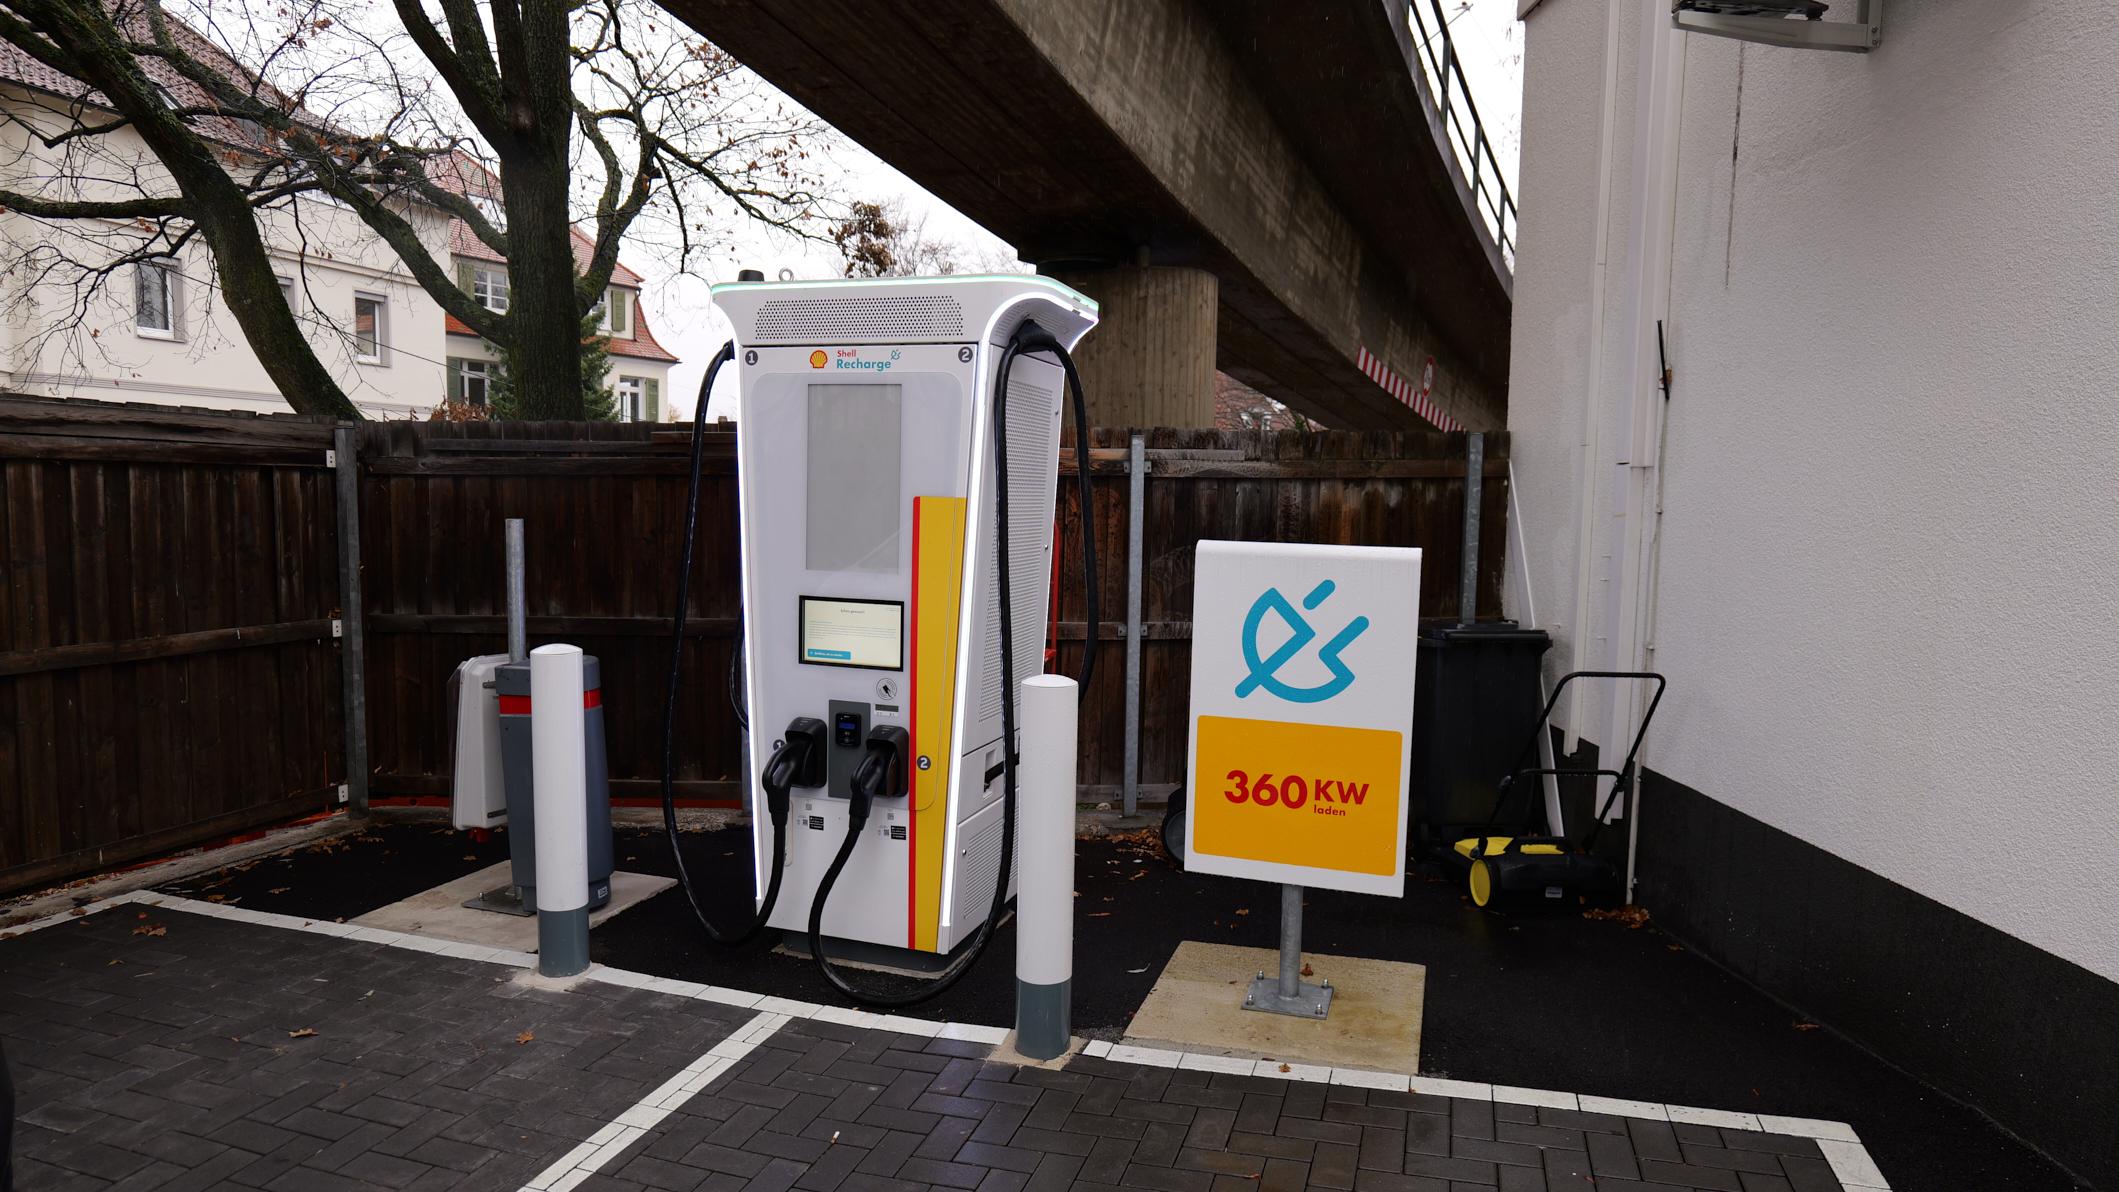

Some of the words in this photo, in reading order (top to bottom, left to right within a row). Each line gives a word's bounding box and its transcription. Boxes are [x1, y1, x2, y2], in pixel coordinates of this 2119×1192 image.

[836, 358, 891, 371] Recharge
[1224, 769, 1308, 809] 360
[1314, 779, 1370, 805] KW
[1313, 804, 1346, 816] laden
